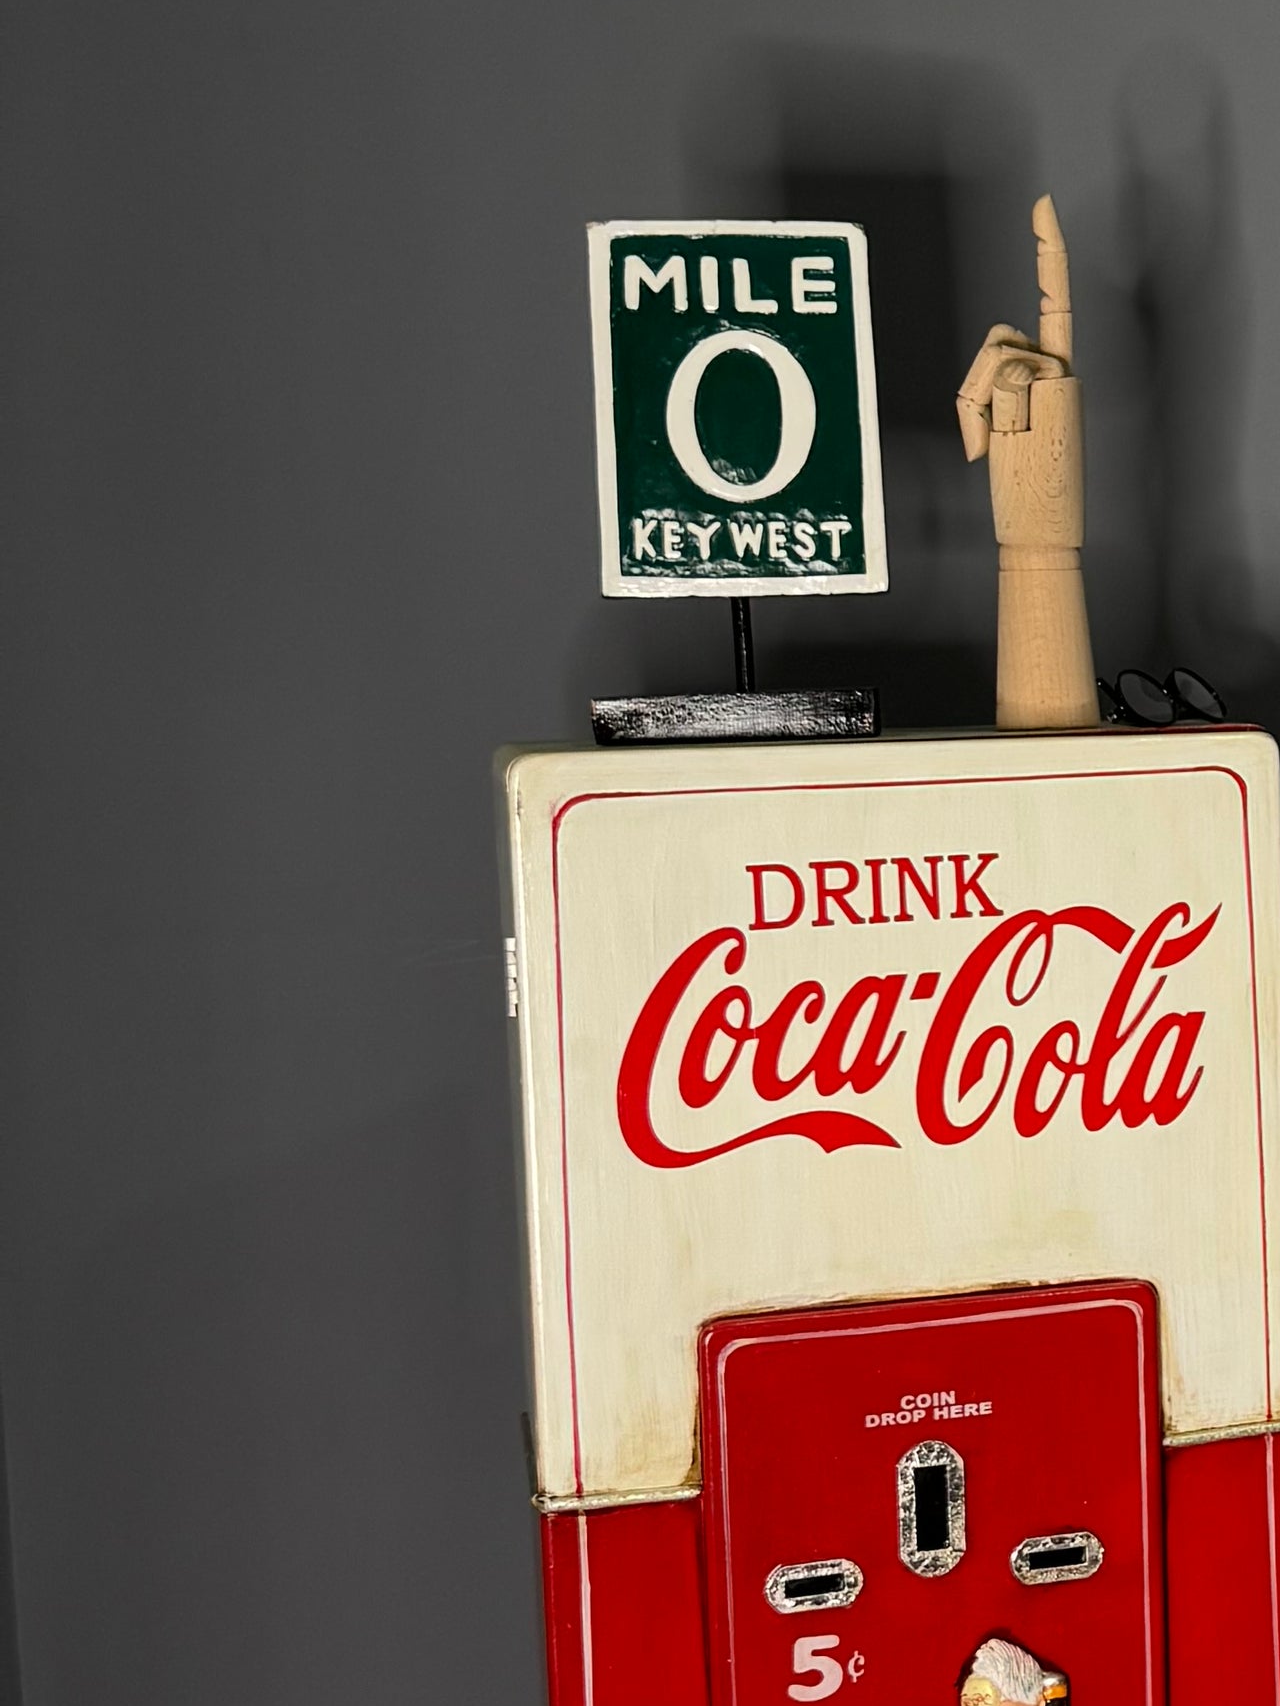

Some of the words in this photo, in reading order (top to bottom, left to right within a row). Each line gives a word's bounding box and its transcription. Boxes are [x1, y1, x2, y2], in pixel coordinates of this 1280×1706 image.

[623, 255, 838, 314] MILE
[631, 517, 722, 561] KEY
[728, 517, 852, 562] WEST
[746, 853, 1004, 931] DRINK
[617, 901, 1222, 1169] Coca-Cola
[865, 1410, 926, 1428] DROP
[934, 1401, 993, 1422] HERE
[900, 1391, 956, 1411] COIN
